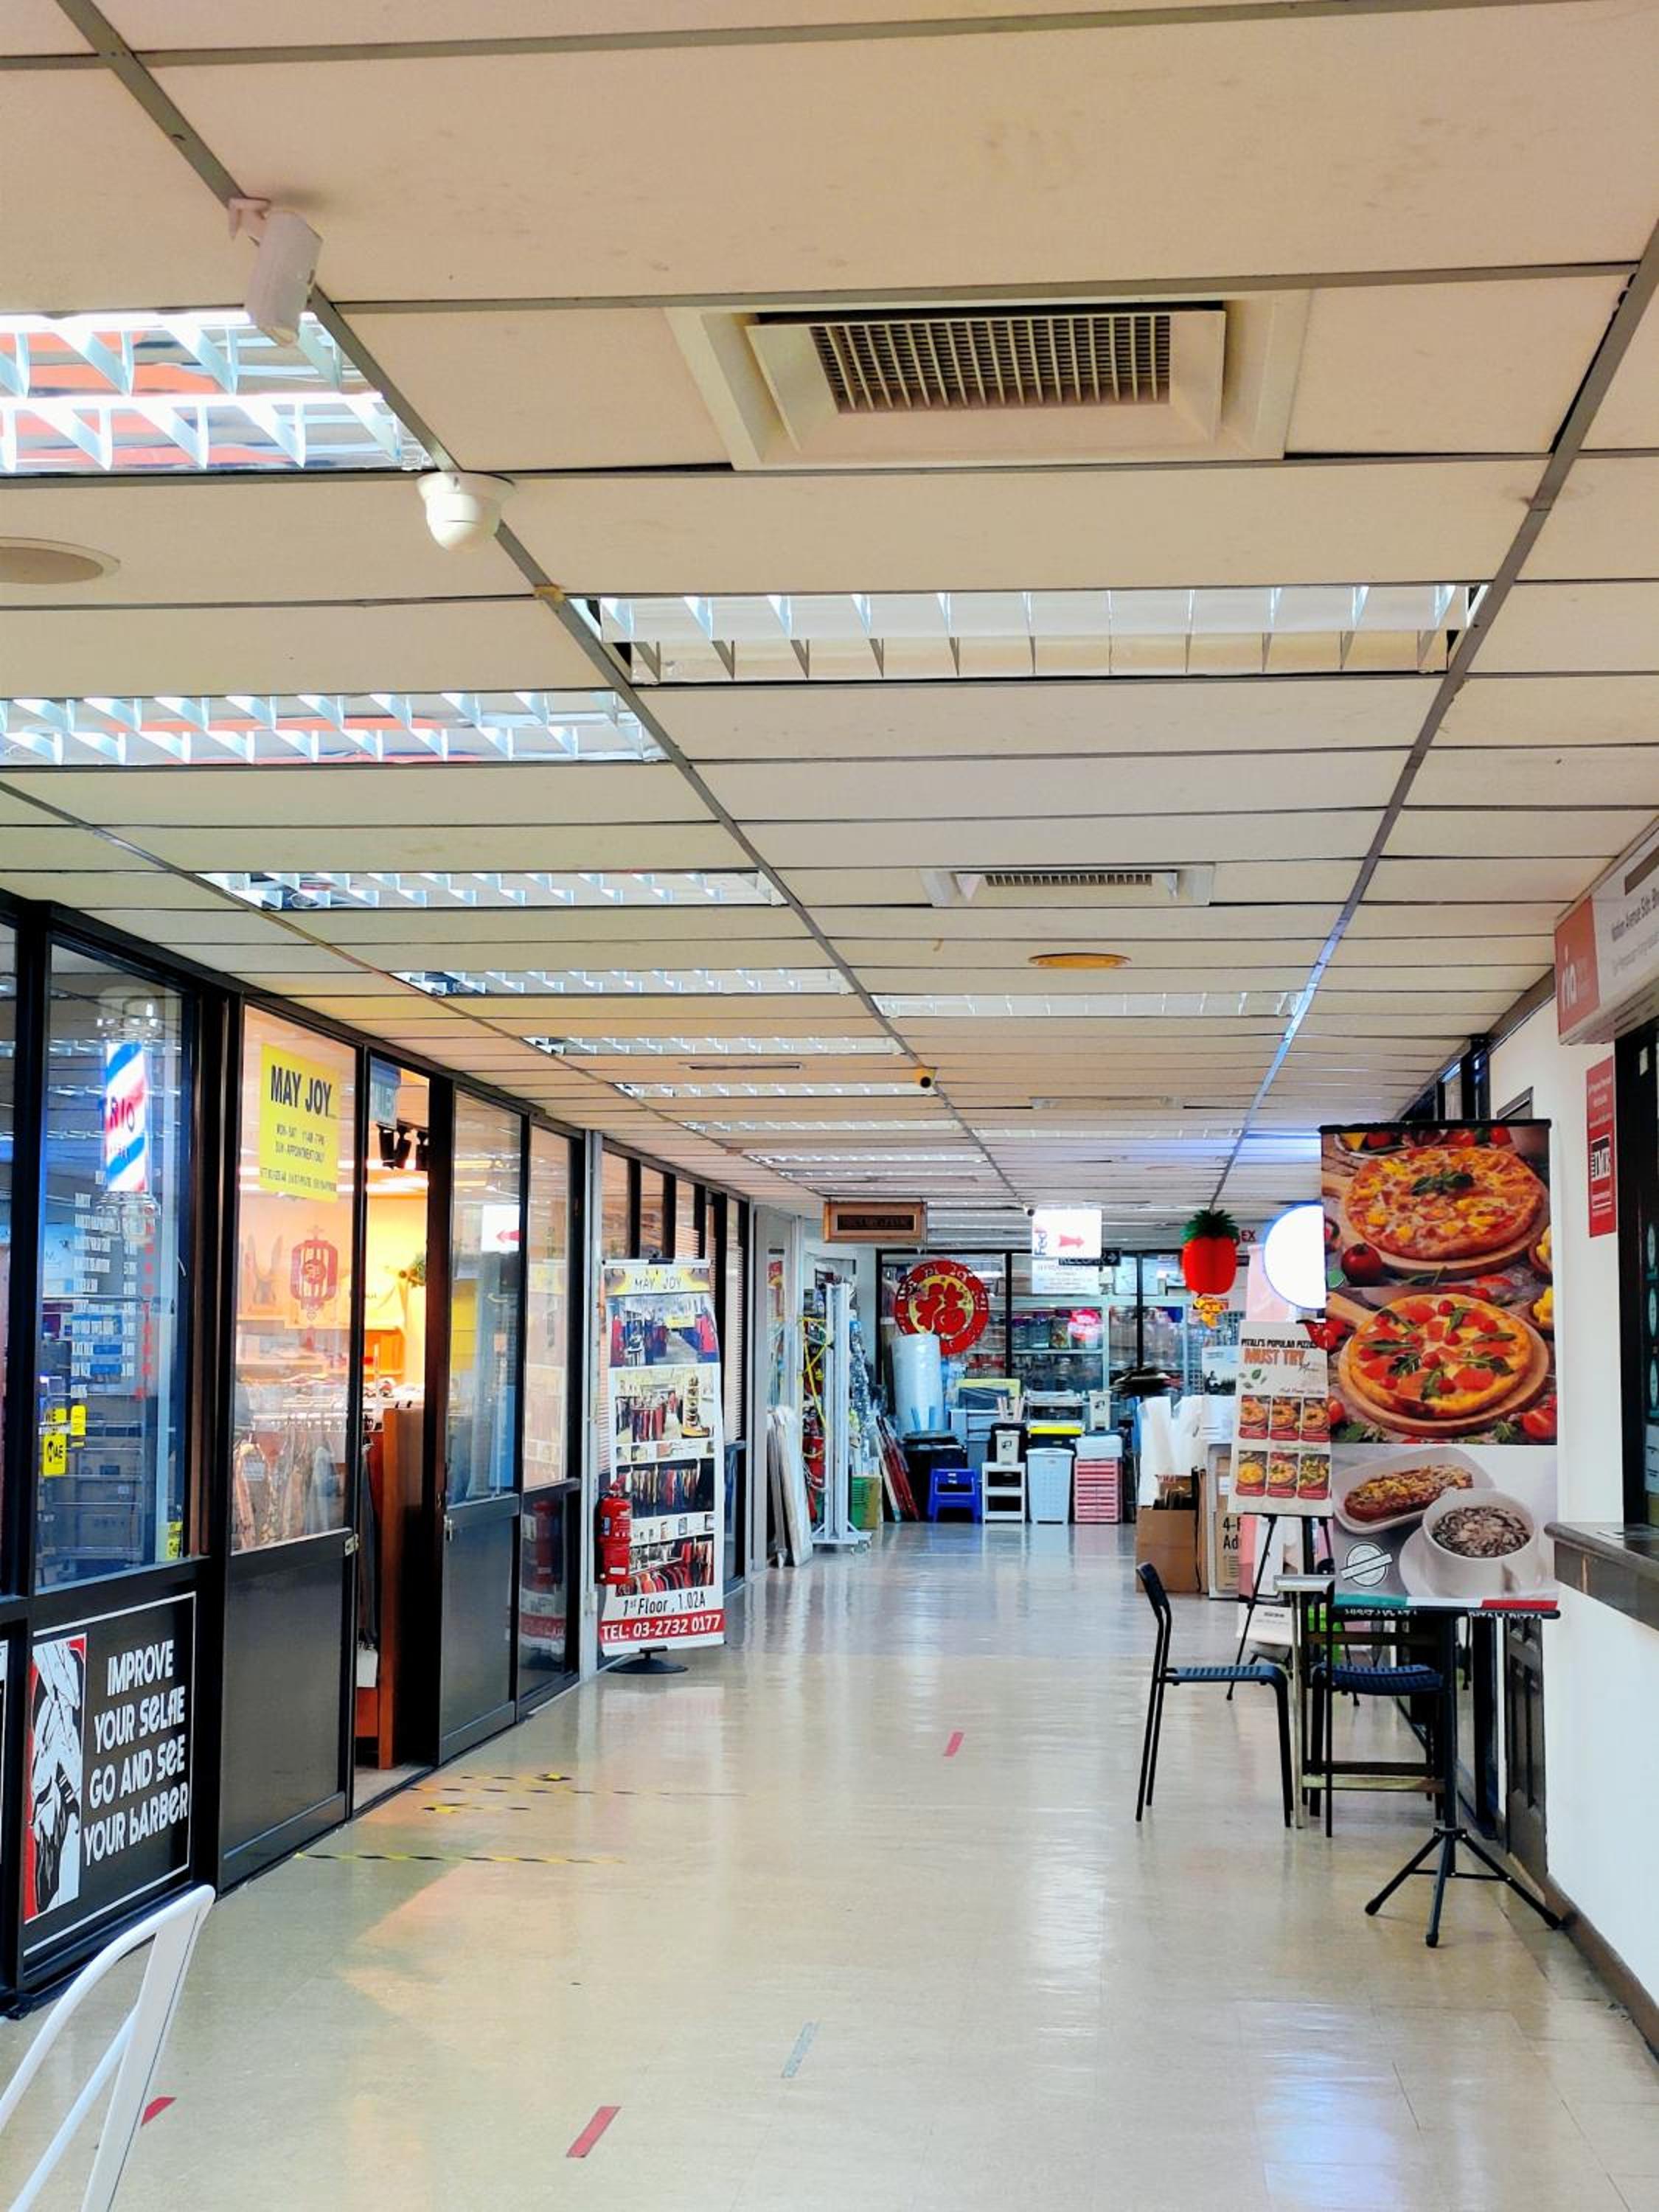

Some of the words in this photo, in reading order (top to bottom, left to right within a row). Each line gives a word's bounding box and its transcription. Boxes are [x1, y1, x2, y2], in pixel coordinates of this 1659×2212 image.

[271, 1065, 302, 1108] MAY
[305, 1077, 333, 1117] JOY
[635, 1277, 655, 1290] MAY
[663, 1276, 683, 1290] JOY
[1244, 1348, 1280, 1366] MUST
[1282, 1349, 1307, 1366] TRY
[1267, 1339, 1295, 1349] POPULAR
[623, 1599, 636, 1617] 1st
[638, 1597, 669, 1615] Floor
[678, 1590, 706, 1609] 1.02A
[602, 1624, 630, 1641] TEL:
[633, 1618, 689, 1638] 03-2732
[691, 1614, 722, 1632] 0177
[106, 1639, 175, 1697] IMPROVE
[94, 1703, 135, 1754] YOUR
[89, 1764, 116, 1809] GO
[119, 1748, 153, 1798] AND
[83, 1812, 125, 1867] YOUR
